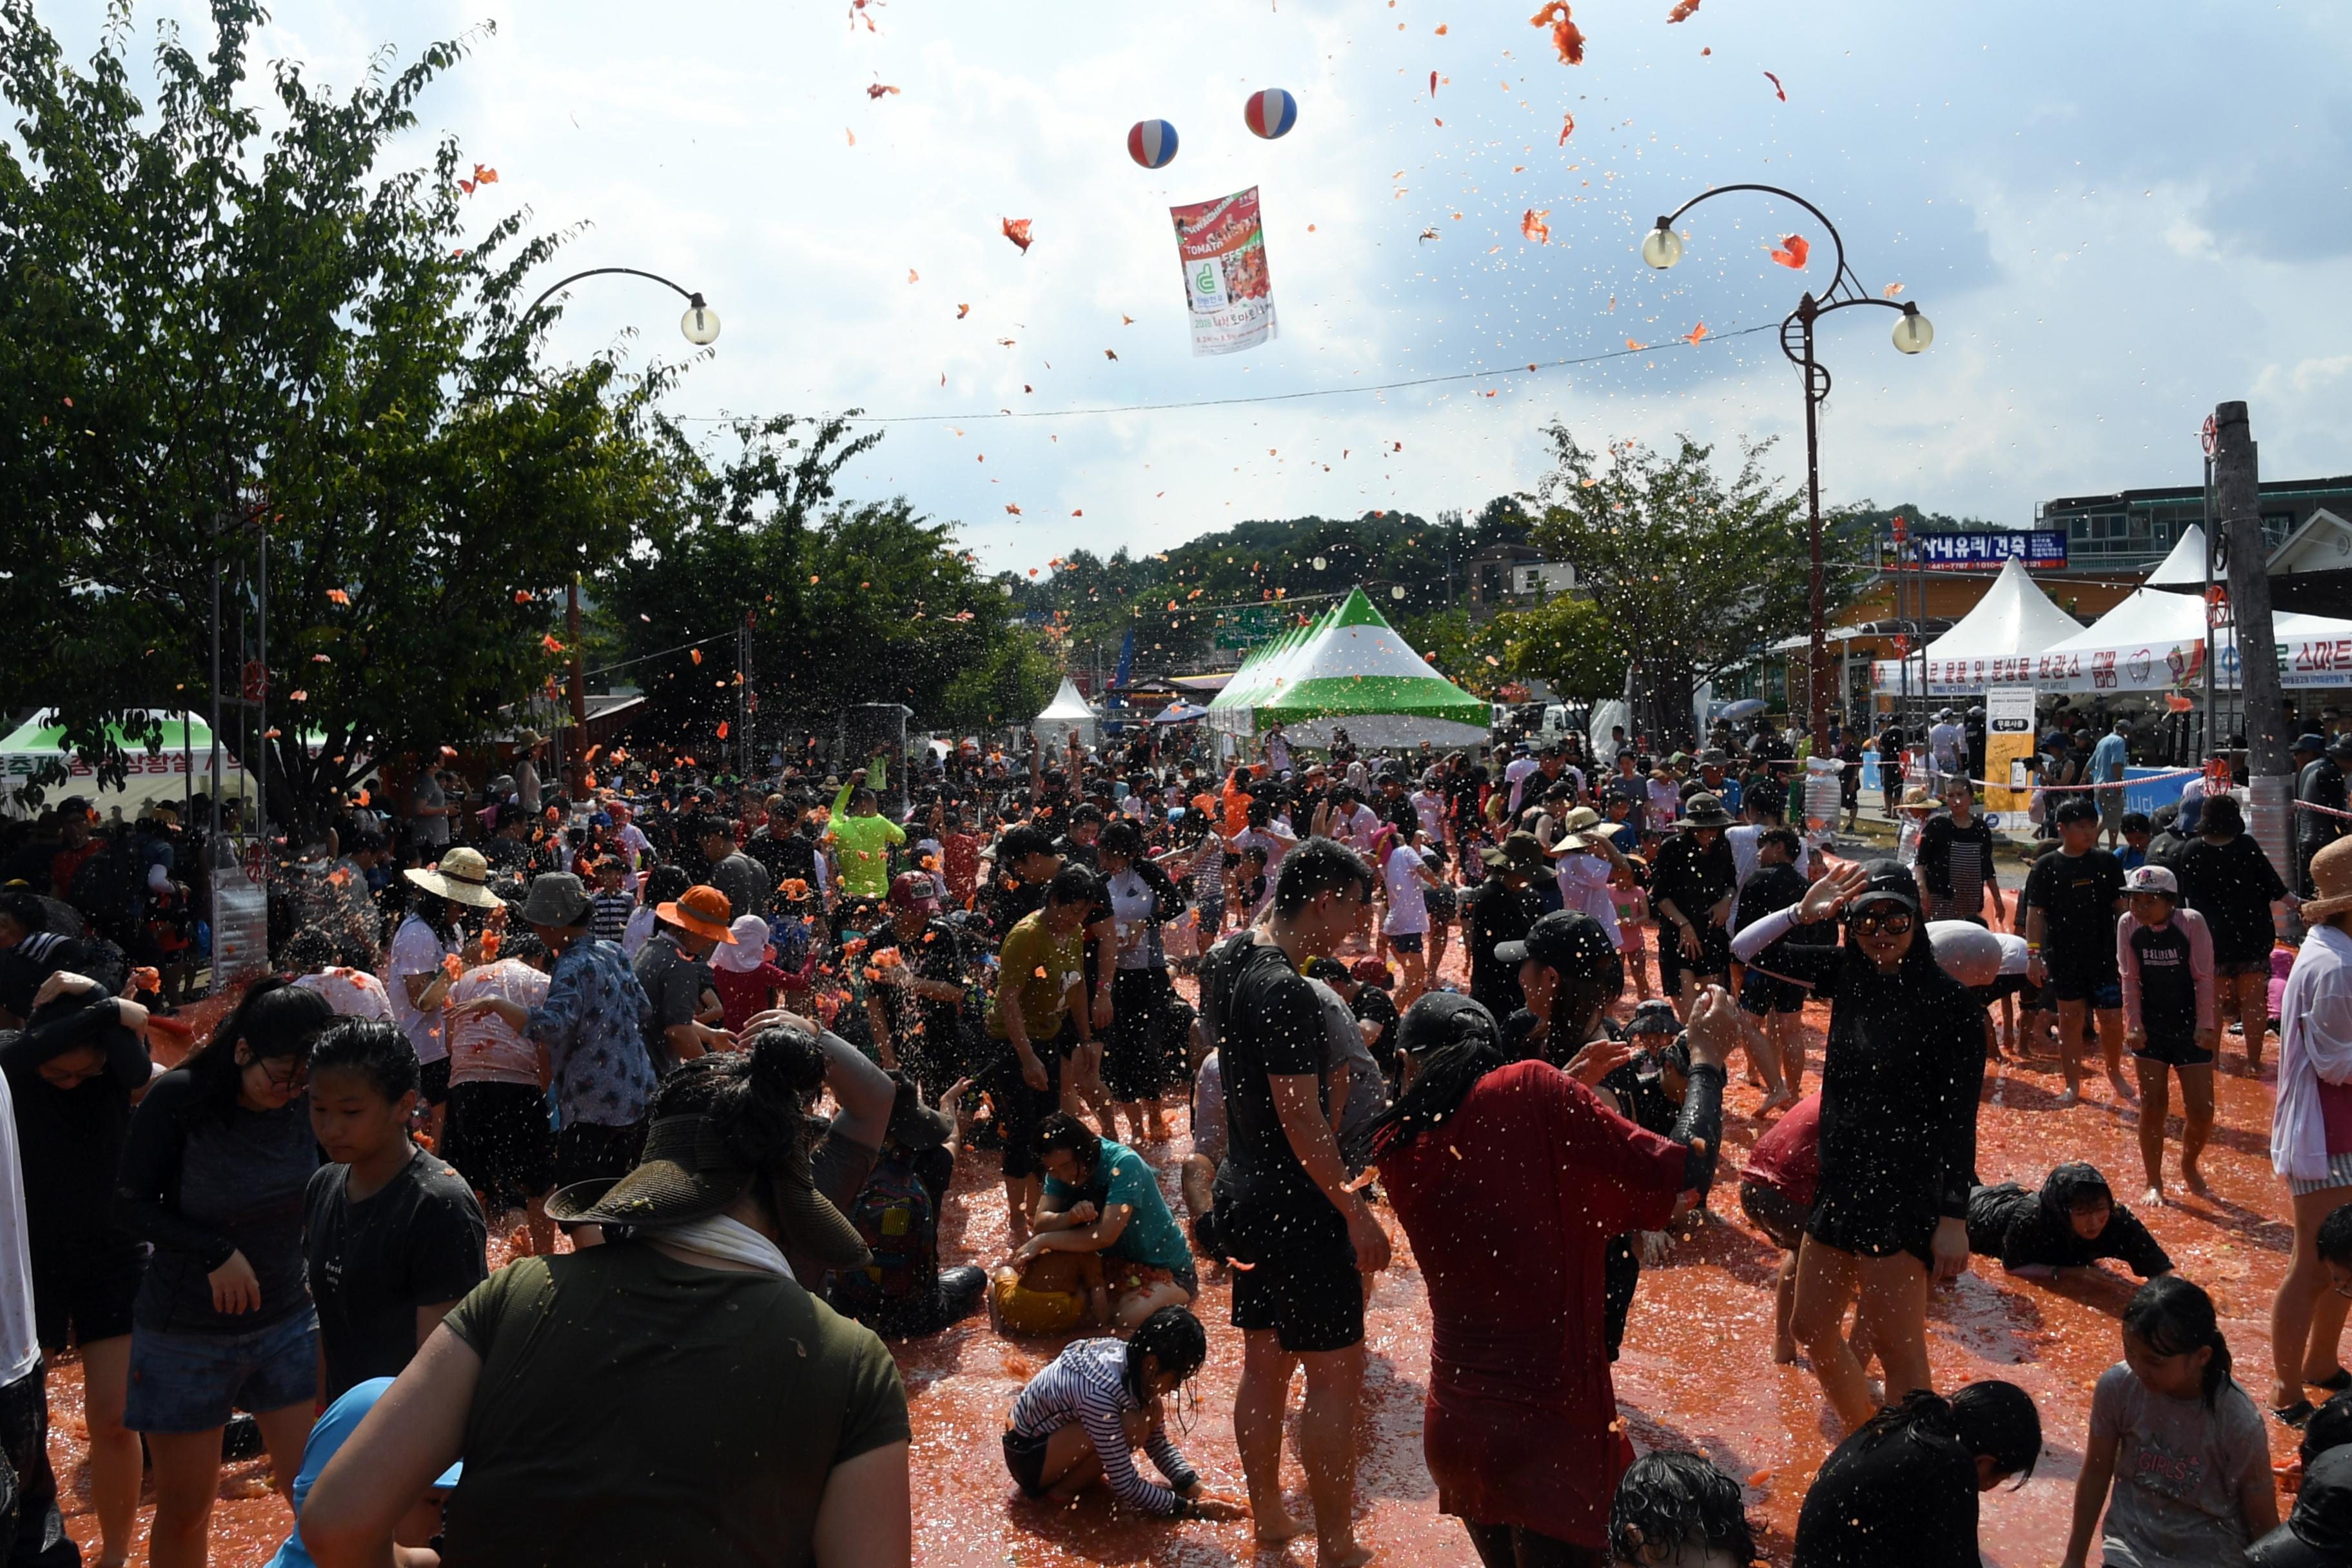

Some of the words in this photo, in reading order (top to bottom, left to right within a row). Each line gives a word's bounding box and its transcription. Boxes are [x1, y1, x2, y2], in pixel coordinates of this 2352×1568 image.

[1188, 195, 1235, 235] HWACHEON
[1186, 241, 1224, 255] TOMATO
[1195, 318, 1212, 329] 2018
[1945, 661, 1966, 683] 물품
[1974, 660, 1984, 683] 및
[1992, 657, 2030, 682] 분실물
[2039, 653, 2081, 679] 보관소
[2295, 639, 2352, 671] 스마트
[2050, 681, 2069, 690] ARTICLE
[70, 752, 193, 776] 종상황실
[2138, 1452, 2188, 1480] GIRLS
